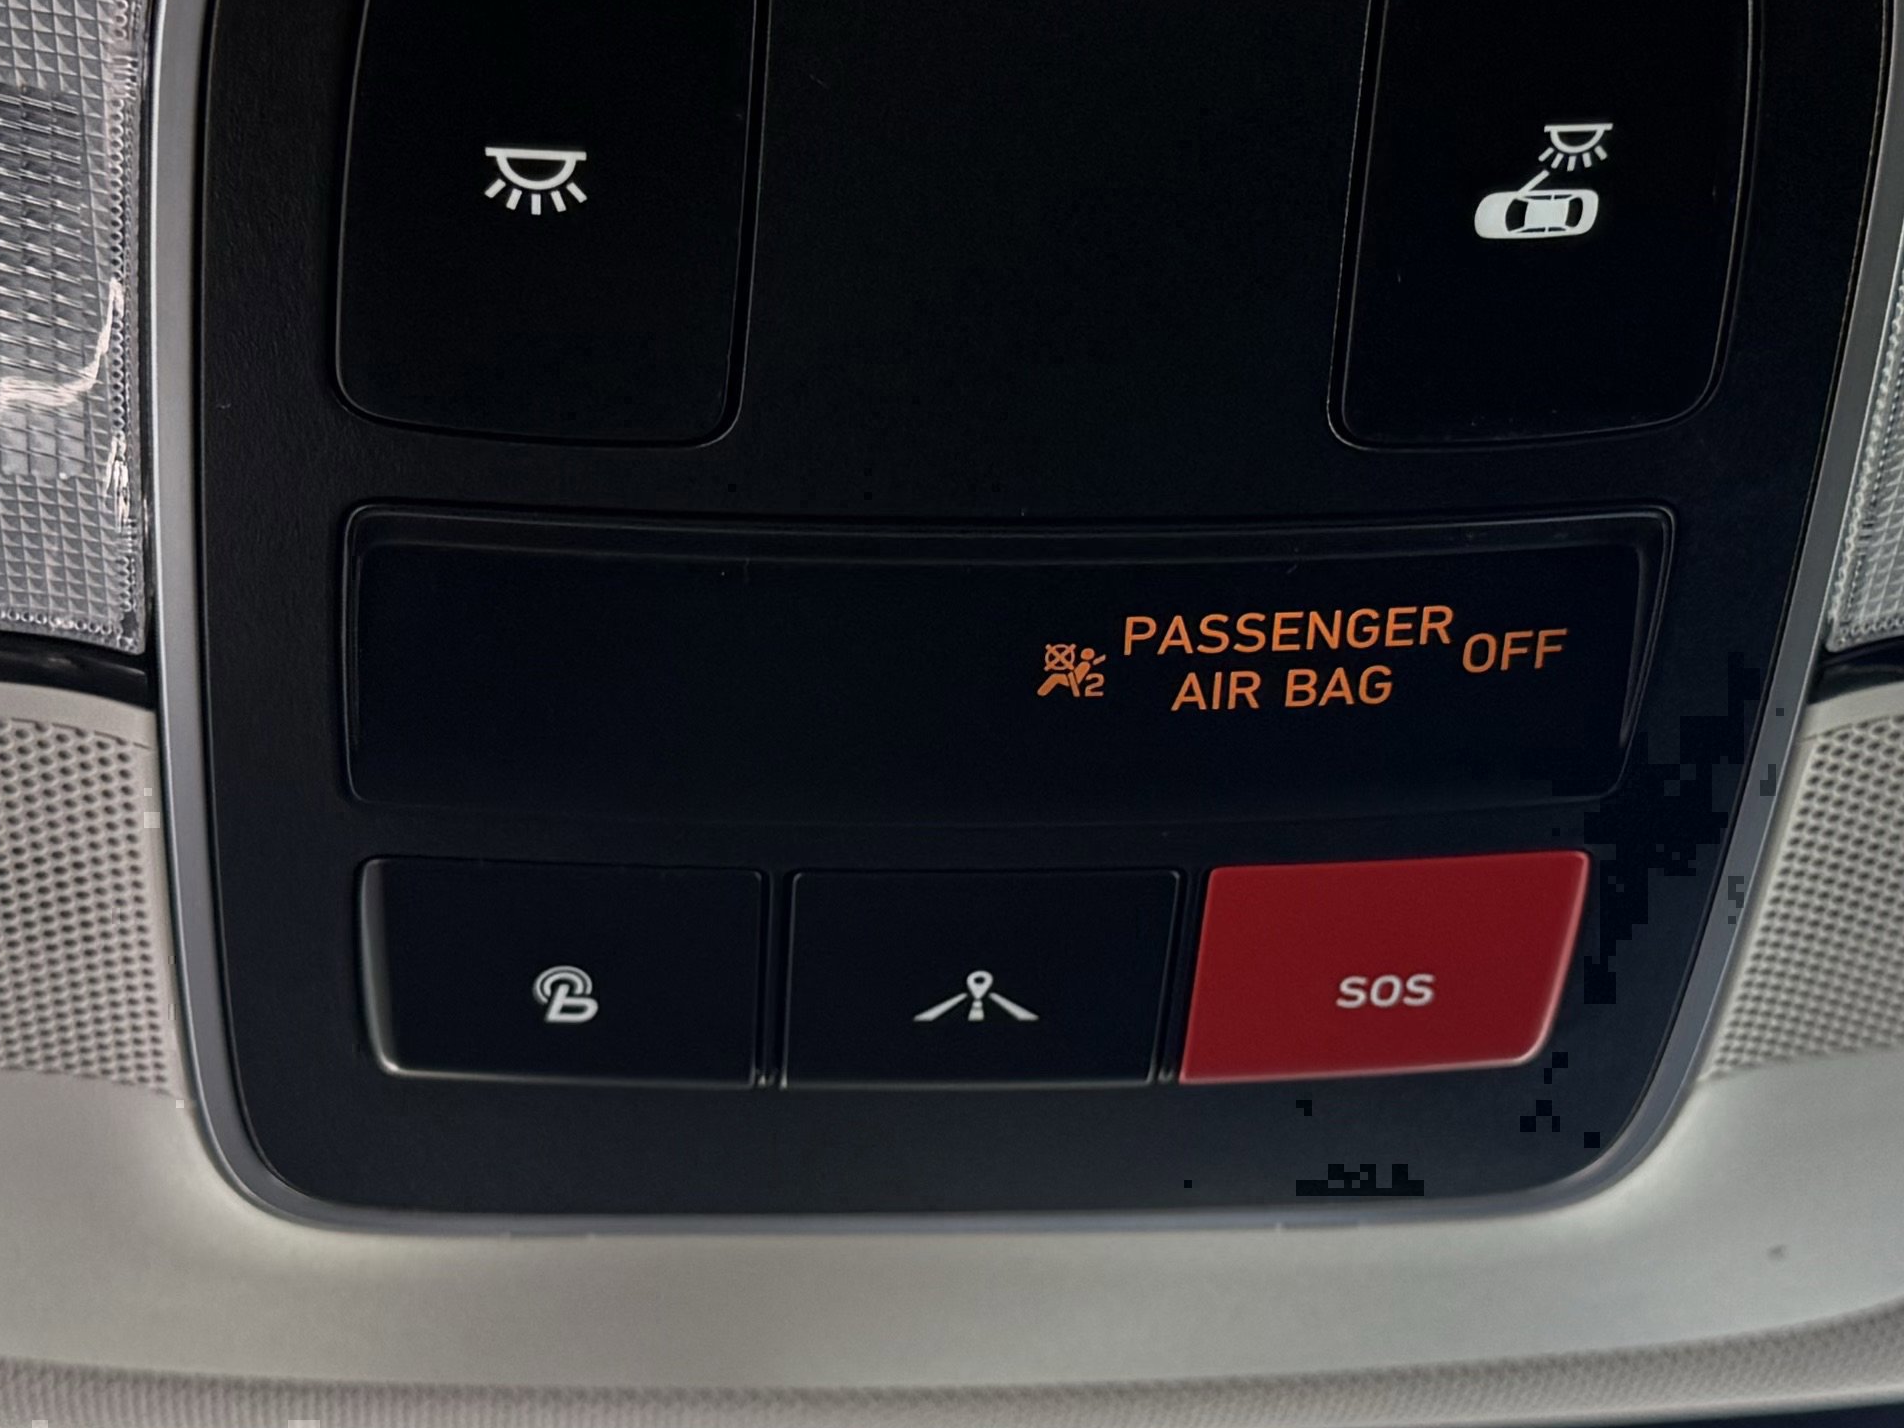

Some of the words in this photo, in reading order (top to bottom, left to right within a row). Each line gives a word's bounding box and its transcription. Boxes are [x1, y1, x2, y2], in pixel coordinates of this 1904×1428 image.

[1124, 604, 1455, 656] PASSENGER
[1462, 629, 1568, 674] OFF
[1172, 669, 1262, 712] AIR
[1285, 664, 1393, 709] BAG
[1336, 973, 1434, 1009] SOS
